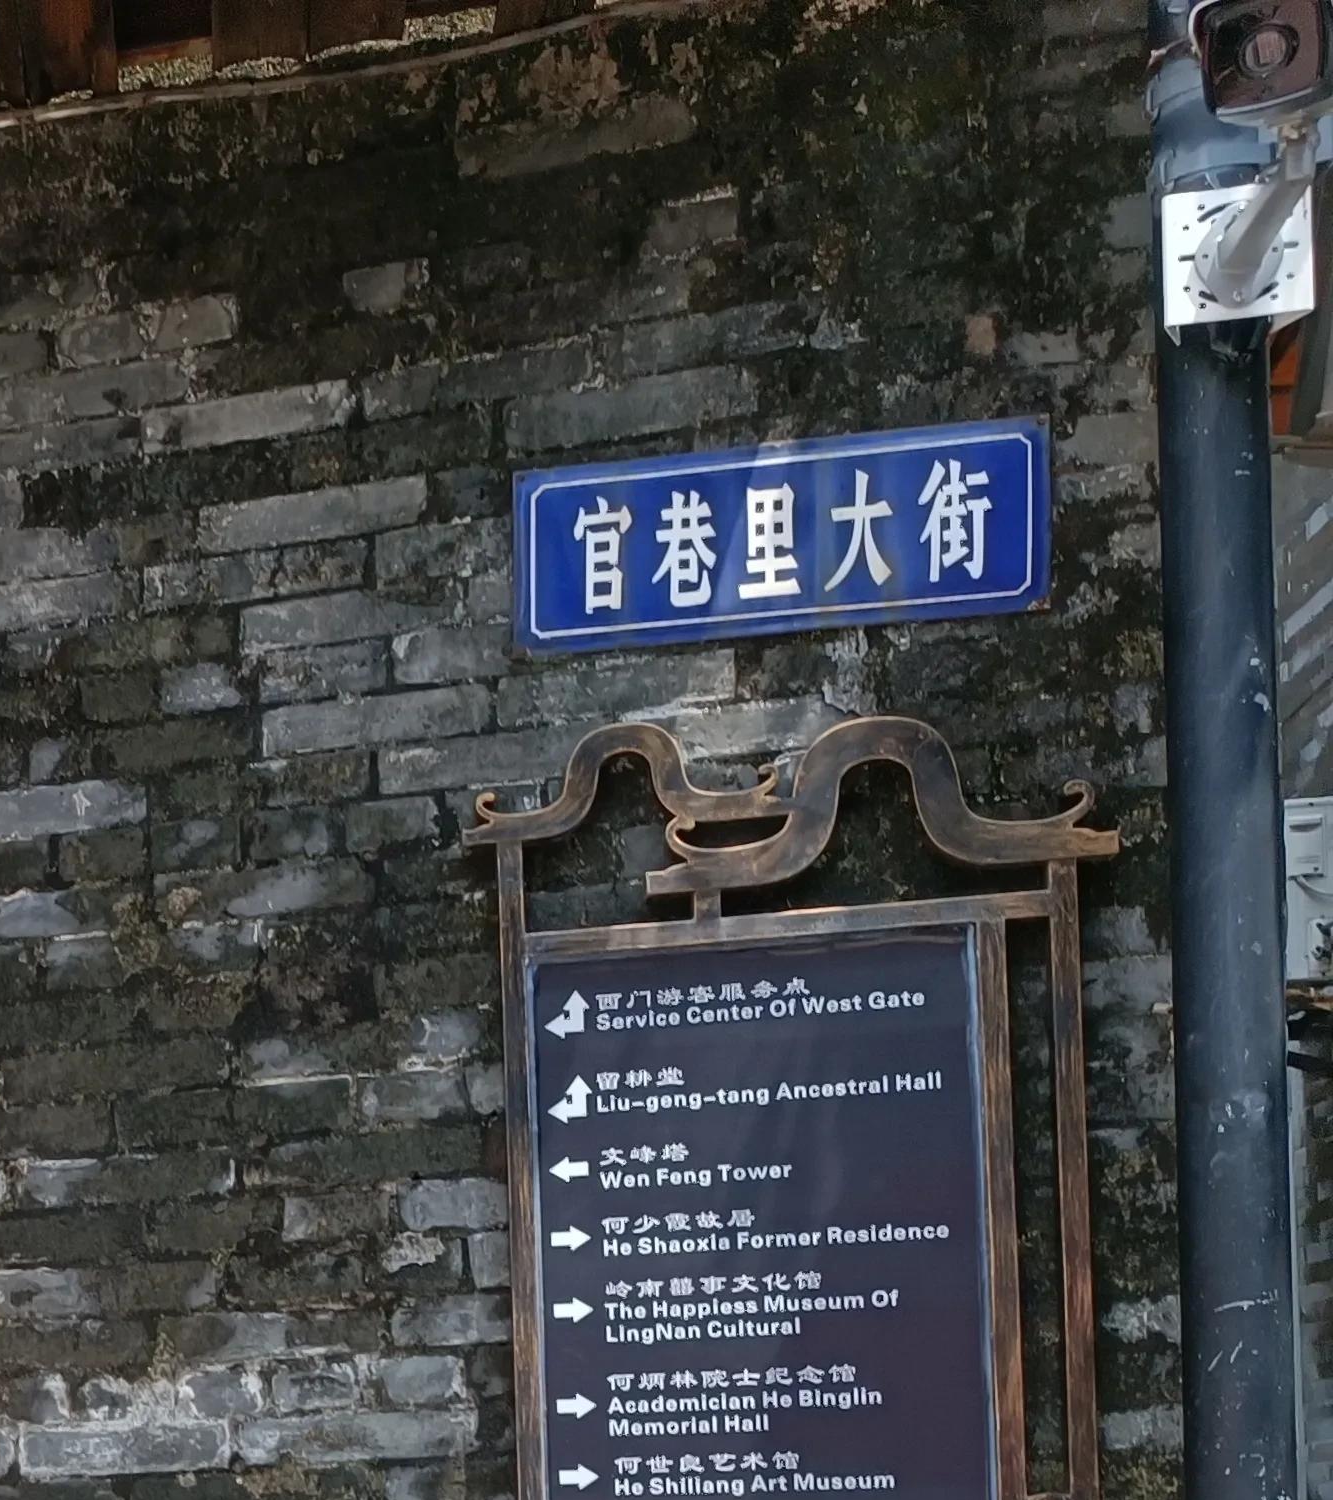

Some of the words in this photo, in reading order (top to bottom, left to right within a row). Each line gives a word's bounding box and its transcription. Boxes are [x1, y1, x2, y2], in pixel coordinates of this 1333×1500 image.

[573, 458, 992, 615] 官巷里大街
[595, 977, 810, 1012] 西门游客服务点
[596, 1010, 681, 1031] Service
[686, 1003, 763, 1025] Center
[769, 999, 795, 1018] Of
[802, 995, 861, 1016] West
[868, 990, 925, 1010] Gate
[596, 1066, 684, 1091] 留耕堂
[776, 1074, 889, 1101] Ancestral
[895, 1070, 942, 1092] Hall
[599, 1142, 689, 1167] 文峰塔
[600, 1171, 650, 1190] Wen
[657, 1168, 711, 1188] Feng
[717, 1163, 792, 1184] Tower
[601, 1209, 755, 1236] 何少霞故居
[602, 1239, 632, 1257] He
[638, 1233, 731, 1256] Shaoxia
[737, 1229, 822, 1251] Former
[827, 1223, 950, 1246] Residence
[605, 1301, 646, 1321] The
[764, 1293, 865, 1315] Museum
[871, 1289, 899, 1309] Of
[605, 1323, 701, 1345] LingNan
[707, 1316, 801, 1339] Cultural
[608, 1393, 755, 1415] Academician
[762, 1391, 792, 1410] He
[798, 1388, 882, 1412] Binglin
[609, 1415, 717, 1437] Memorial
[724, 1414, 769, 1434] Hall
[614, 1451, 800, 1476] 何世良艺术馆
[614, 1479, 643, 1497] He
[648, 1476, 745, 1498] Shiliang
[750, 1475, 788, 1494] Art
[793, 1472, 895, 1493] Museum
